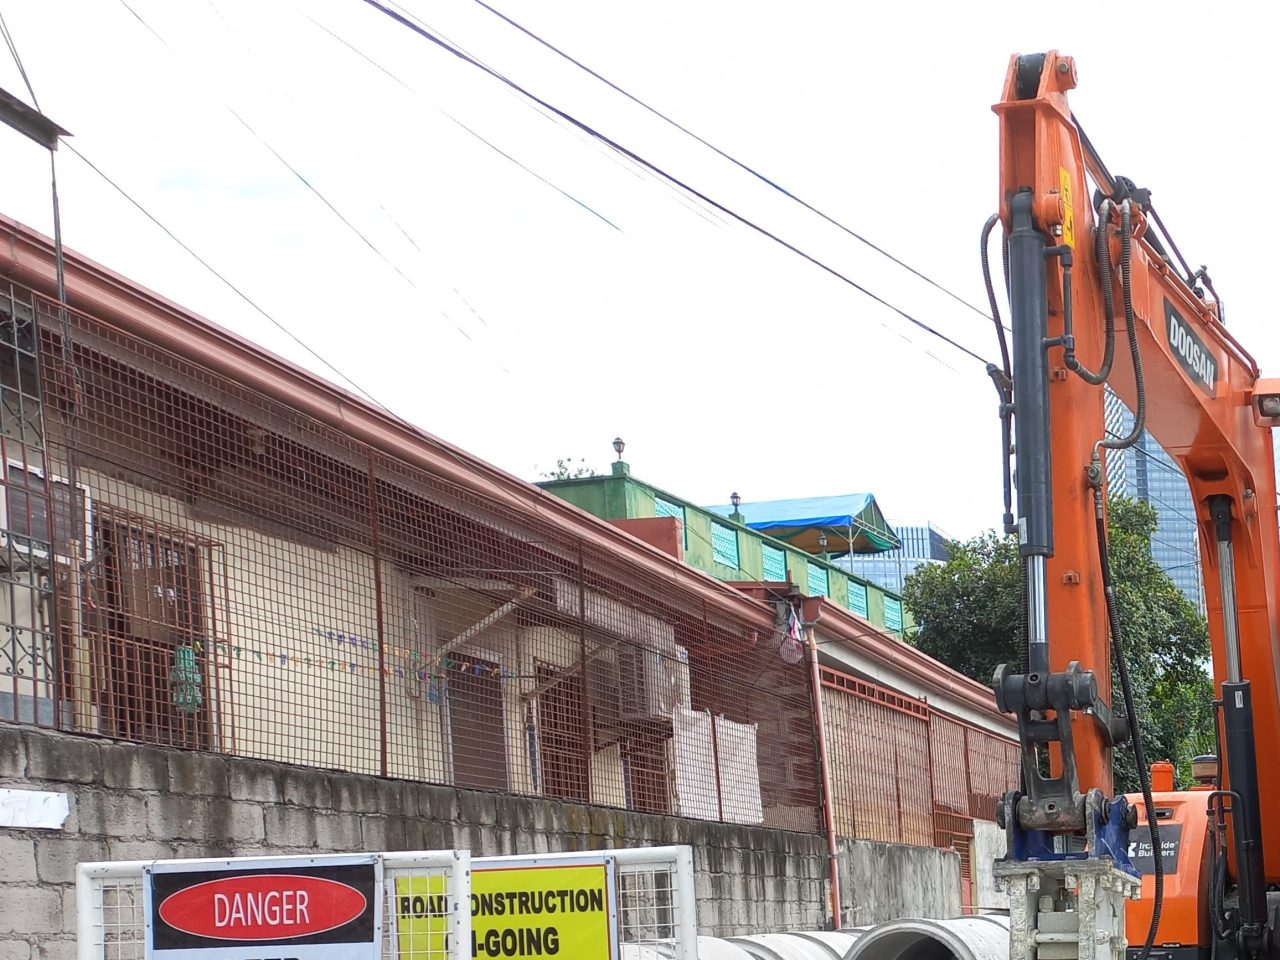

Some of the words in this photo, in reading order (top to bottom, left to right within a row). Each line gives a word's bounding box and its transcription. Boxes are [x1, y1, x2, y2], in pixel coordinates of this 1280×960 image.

[1170, 315, 1214, 390] DOOSAN
[1138, 849, 1175, 858] Buiers
[1139, 841, 1175, 850] Iroide
[213, 889, 310, 927] DANGER
[471, 889, 604, 916] ONSTRUCTION
[446, 927, 560, 957] -GOING
